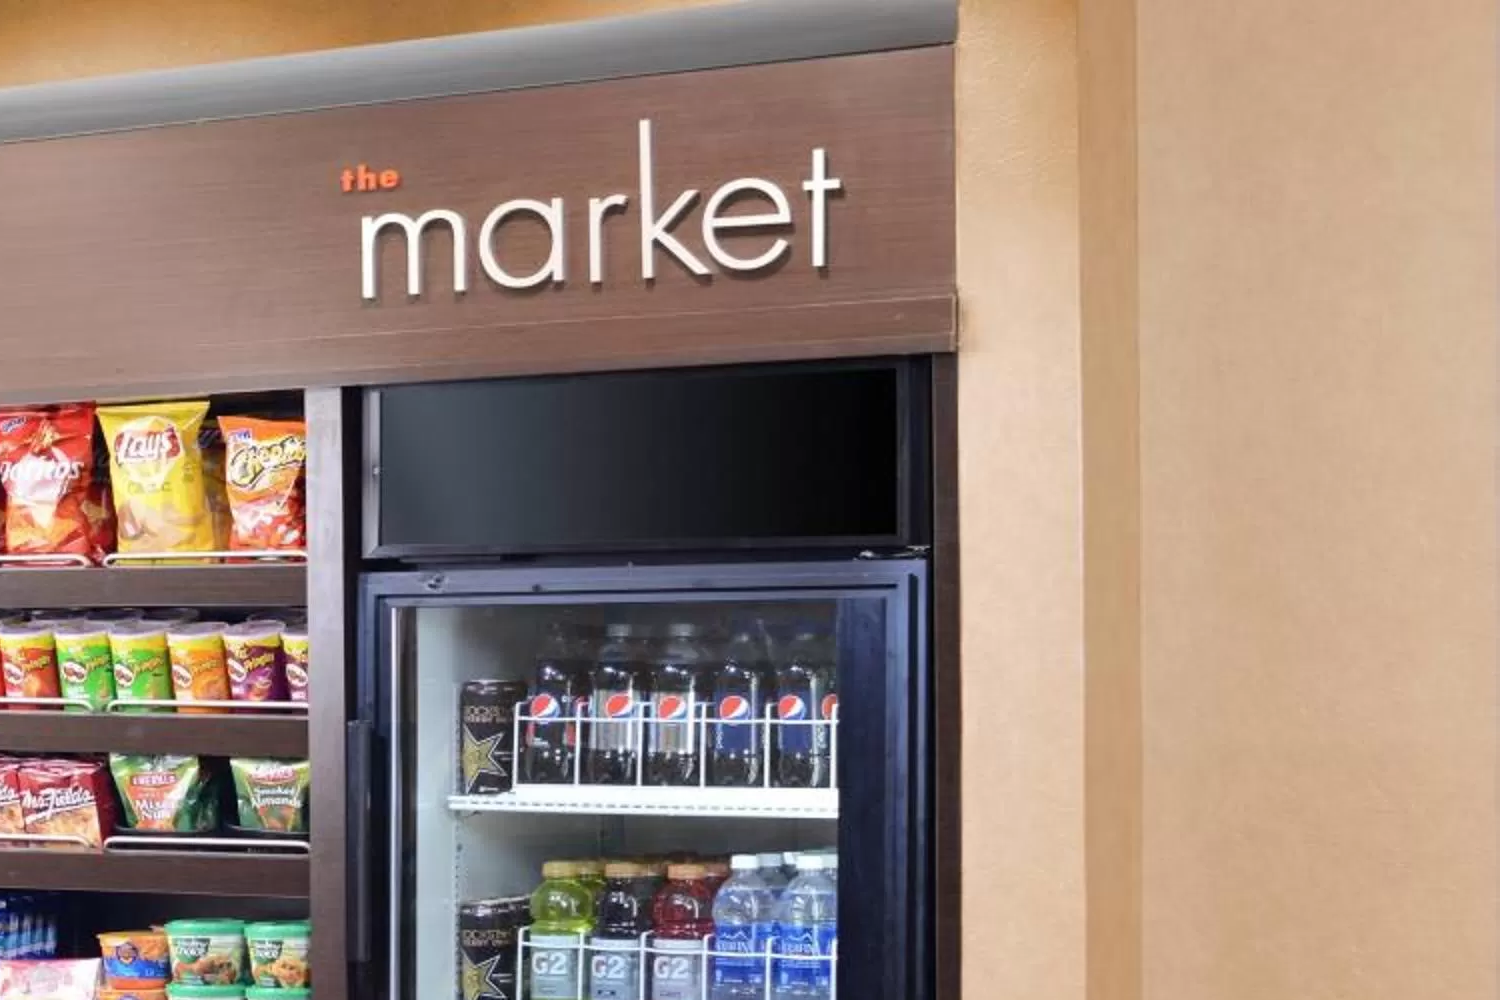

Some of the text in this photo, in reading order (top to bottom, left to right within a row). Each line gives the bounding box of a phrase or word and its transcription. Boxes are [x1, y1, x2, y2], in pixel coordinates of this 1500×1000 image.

[340, 165, 399, 192] the
[361, 118, 842, 299] market
[531, 952, 569, 976] G2
[591, 955, 626, 979] G2
[654, 956, 690, 980] G2
